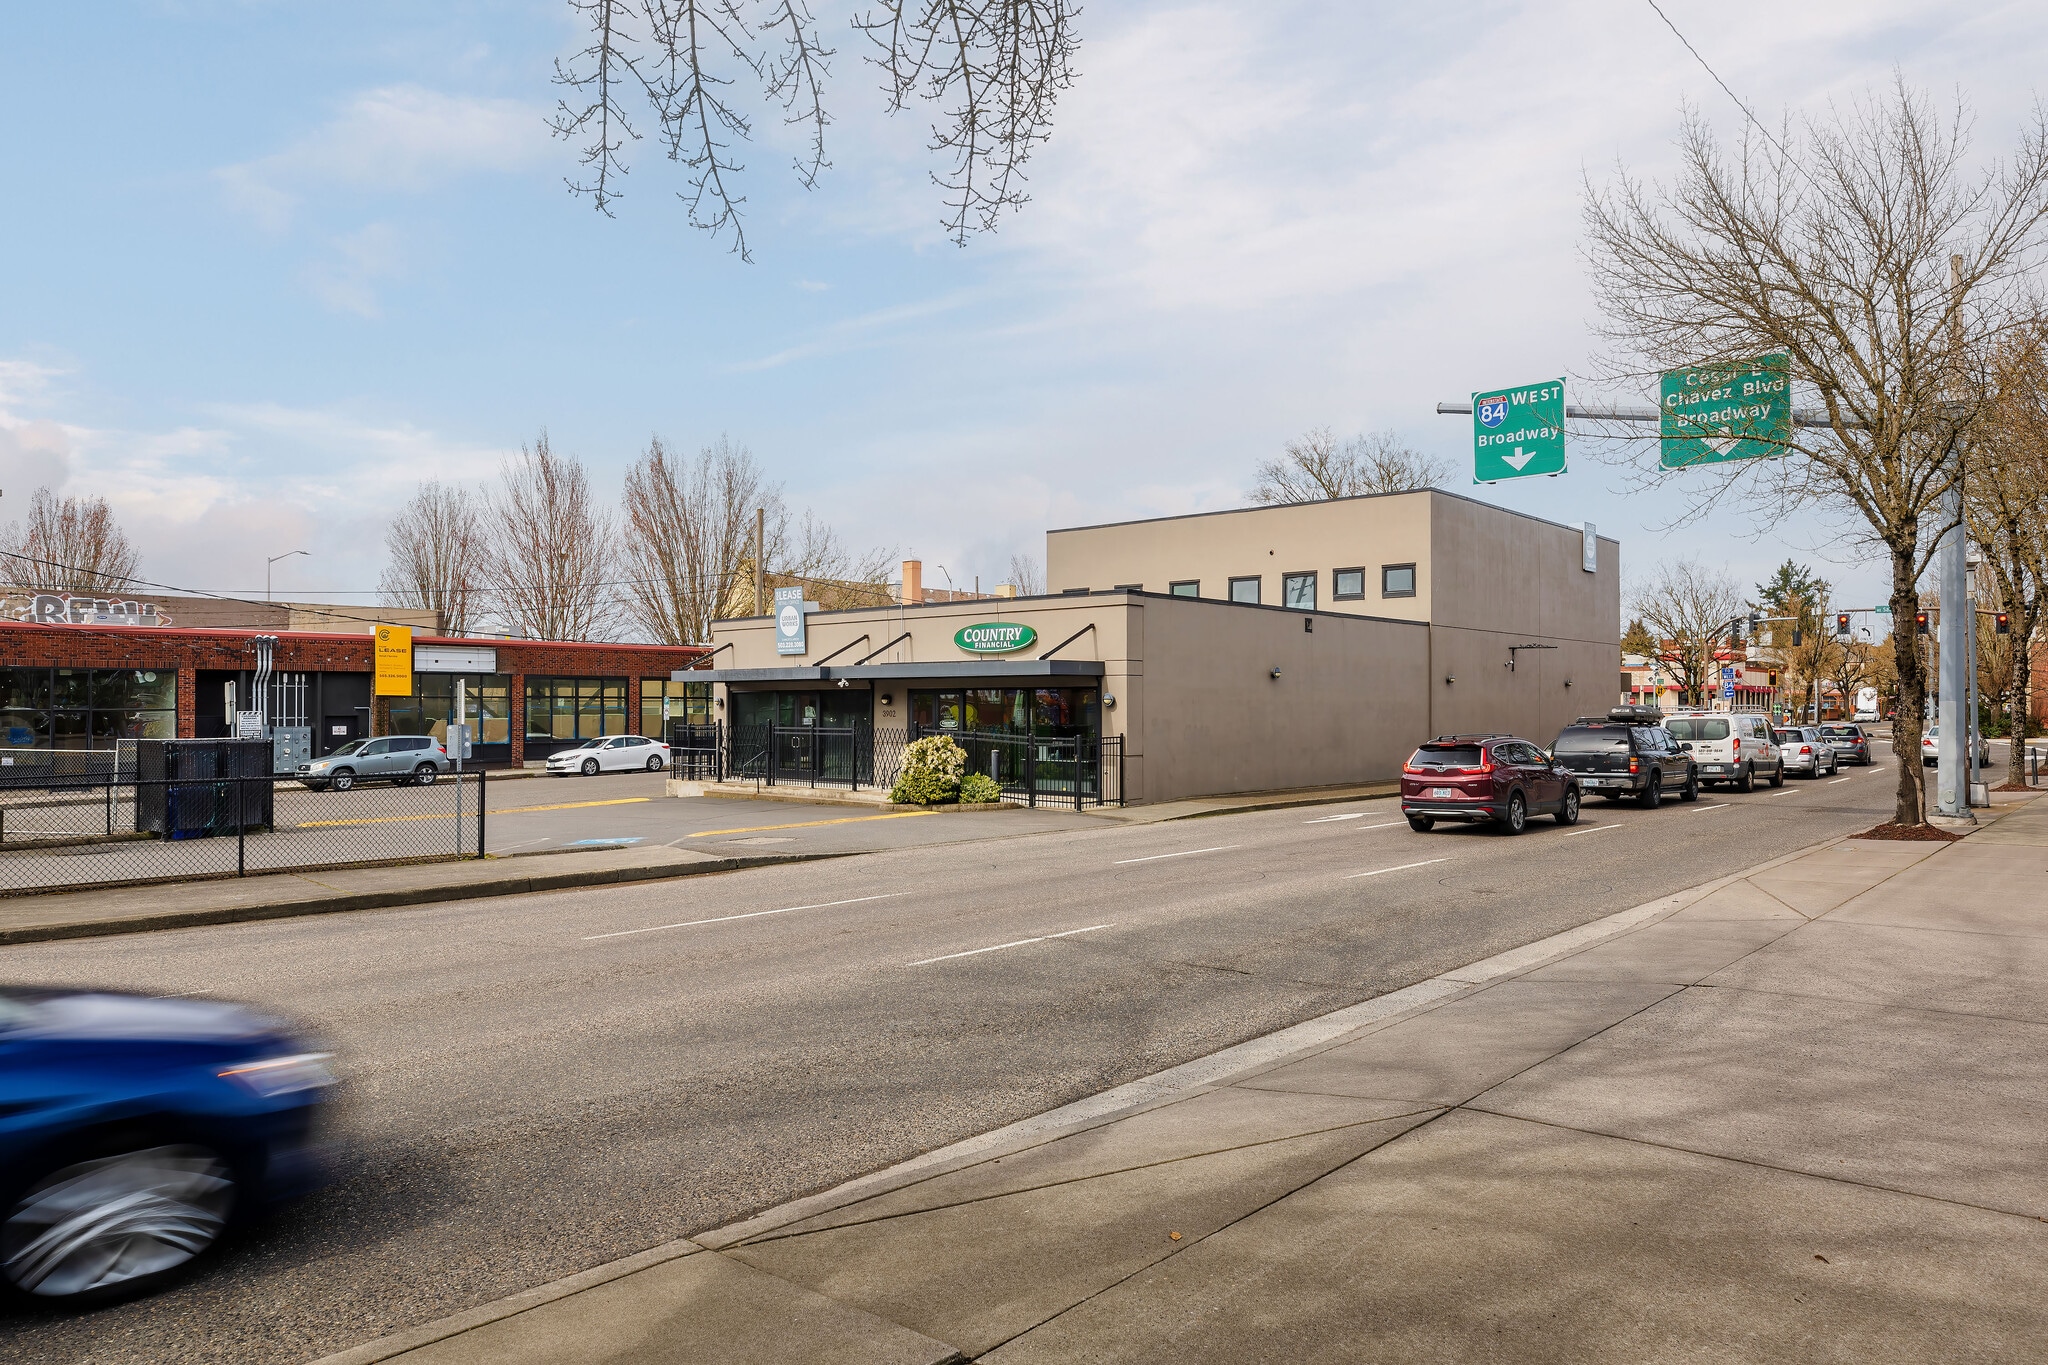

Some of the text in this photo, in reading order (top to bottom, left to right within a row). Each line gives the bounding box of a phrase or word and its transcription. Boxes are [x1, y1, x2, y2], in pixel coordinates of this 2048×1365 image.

[1511, 387, 1560, 406] WEST
[1666, 379, 1784, 407] Chavez Blvd
[1481, 403, 1505, 422] 84
[1677, 404, 1771, 427] Broadway
[1478, 427, 1558, 447] Broadway
[780, 590, 802, 600] LEASE
[963, 627, 1023, 642] COUNTRY
